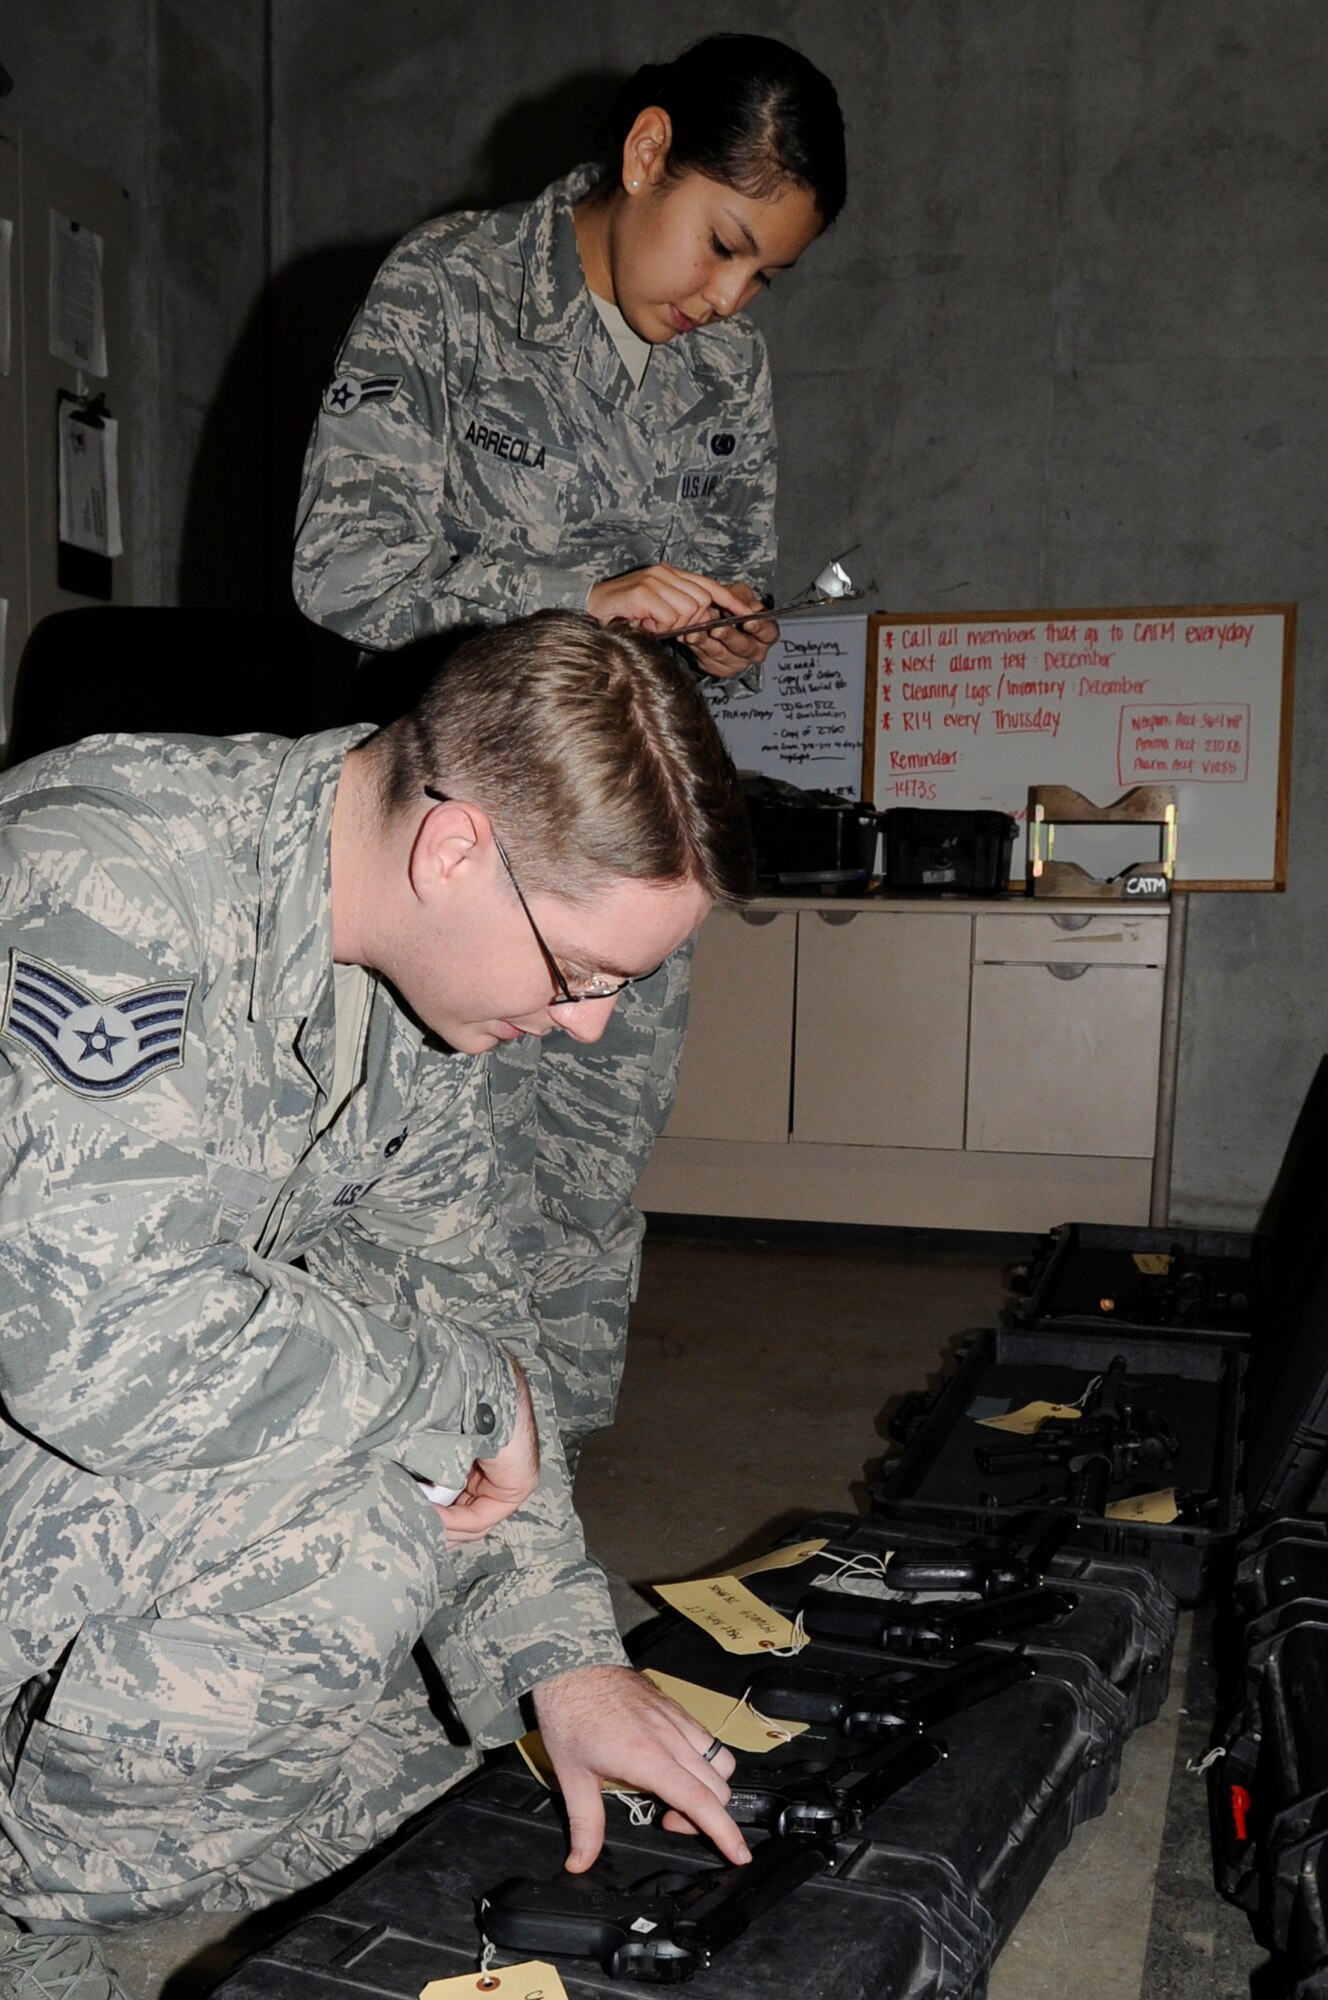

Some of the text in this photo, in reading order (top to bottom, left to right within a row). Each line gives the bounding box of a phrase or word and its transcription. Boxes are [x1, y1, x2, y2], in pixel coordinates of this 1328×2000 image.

[465, 420, 546, 470] ARREOLA
[780, 640, 841, 657] Deploying
[901, 622, 1255, 650] Call all members that go to CATM everyday
[901, 654, 937, 673] Next
[950, 653, 992, 673] alarm
[1044, 650, 1117, 672] December
[902, 682, 959, 709] Cleaning
[965, 682, 992, 706] Logs
[1079, 675, 1150, 697] December
[943, 712, 981, 735] every
[993, 707, 1061, 737] Thursday
[1126, 877, 1167, 894] CATM
